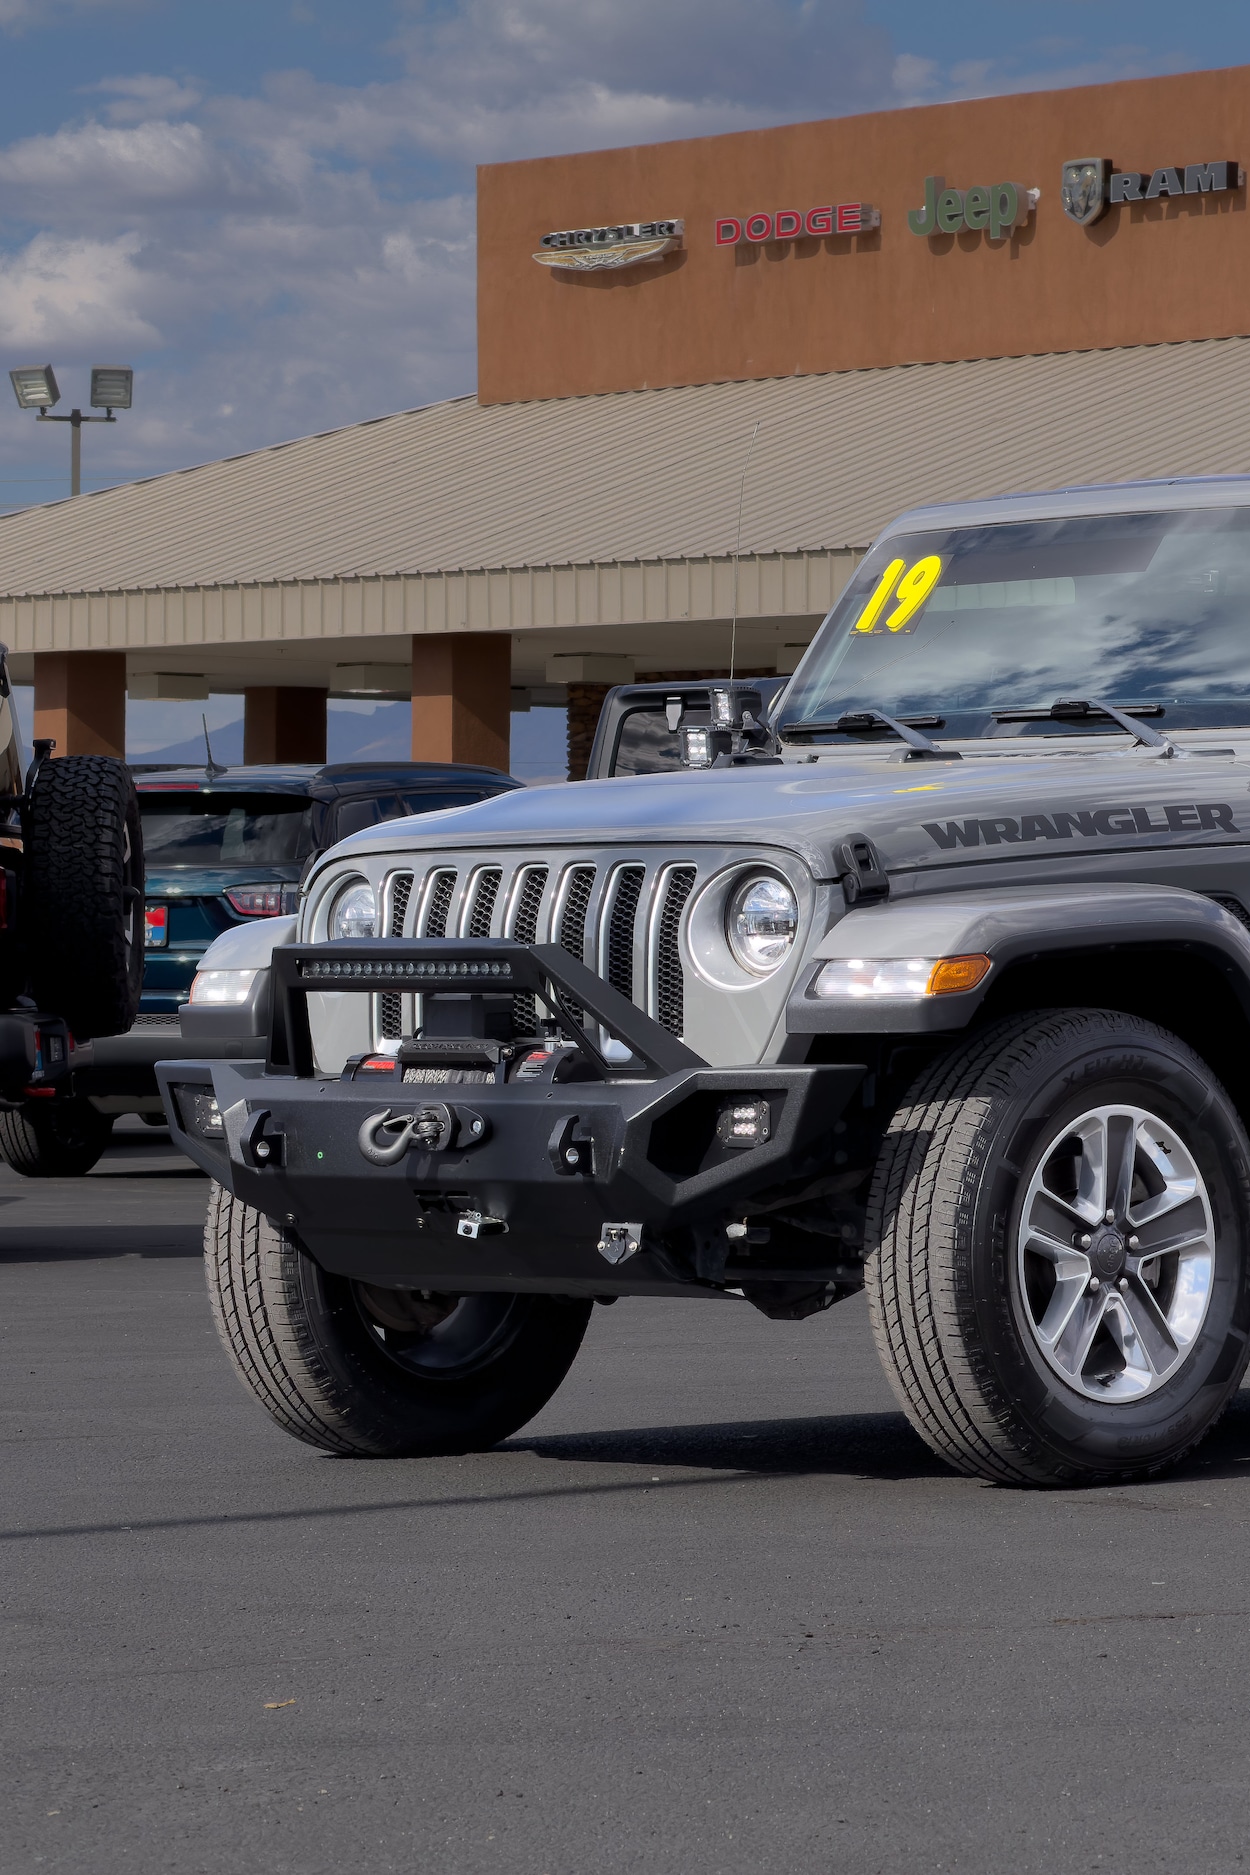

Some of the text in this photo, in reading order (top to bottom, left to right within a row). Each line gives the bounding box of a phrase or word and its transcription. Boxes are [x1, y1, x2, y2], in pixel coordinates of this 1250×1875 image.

[1110, 160, 1235, 203] RAM
[715, 202, 863, 248] DODGE
[909, 176, 1026, 240] Jeep
[539, 219, 677, 249] CHRYSLER
[855, 555, 942, 633] 19
[920, 803, 1241, 850] WRANGLER
